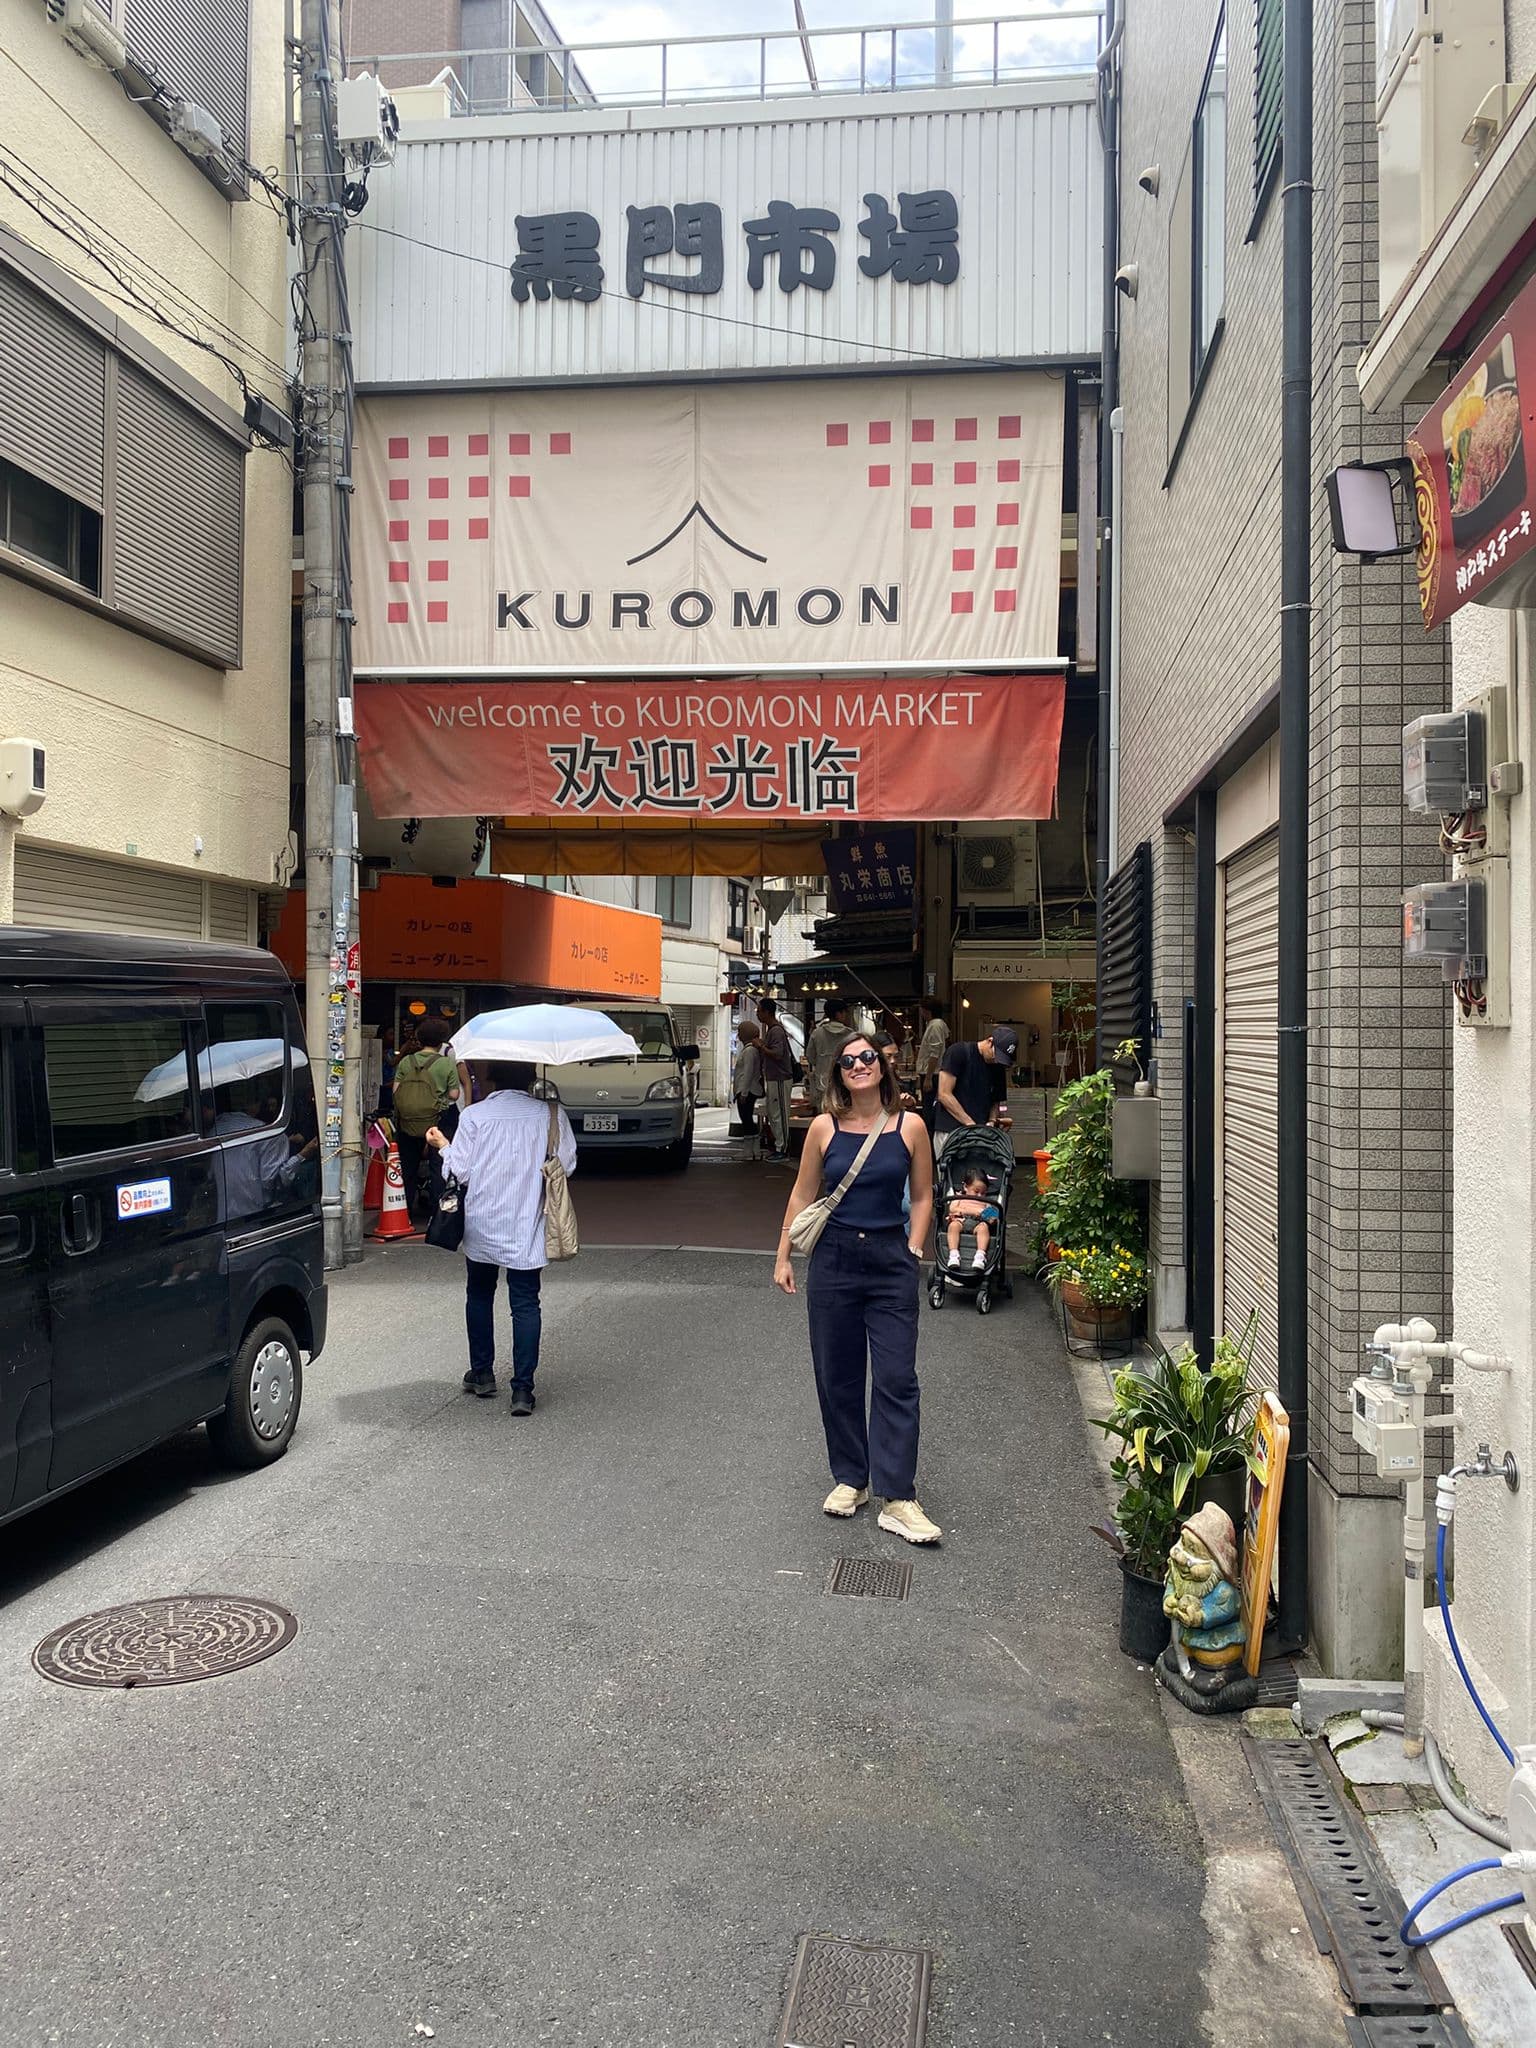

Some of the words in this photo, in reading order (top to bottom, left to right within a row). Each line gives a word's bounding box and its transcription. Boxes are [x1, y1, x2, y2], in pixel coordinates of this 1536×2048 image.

[510, 189, 960, 302] 黒門市場
[495, 583, 902, 632] KUROMON
[427, 696, 581, 728] welcome
[590, 700, 626, 728] to
[636, 694, 822, 728] KUROMON
[834, 691, 982, 727] MARKET
[546, 732, 861, 815] 欢迎光临
[839, 864, 913, 891] 丸栄商店
[406, 919, 472, 934] カレーの店
[391, 952, 488, 967] ニューダルニー
[571, 941, 608, 963] カレーの店
[613, 970, 649, 985] ニューダルニー
